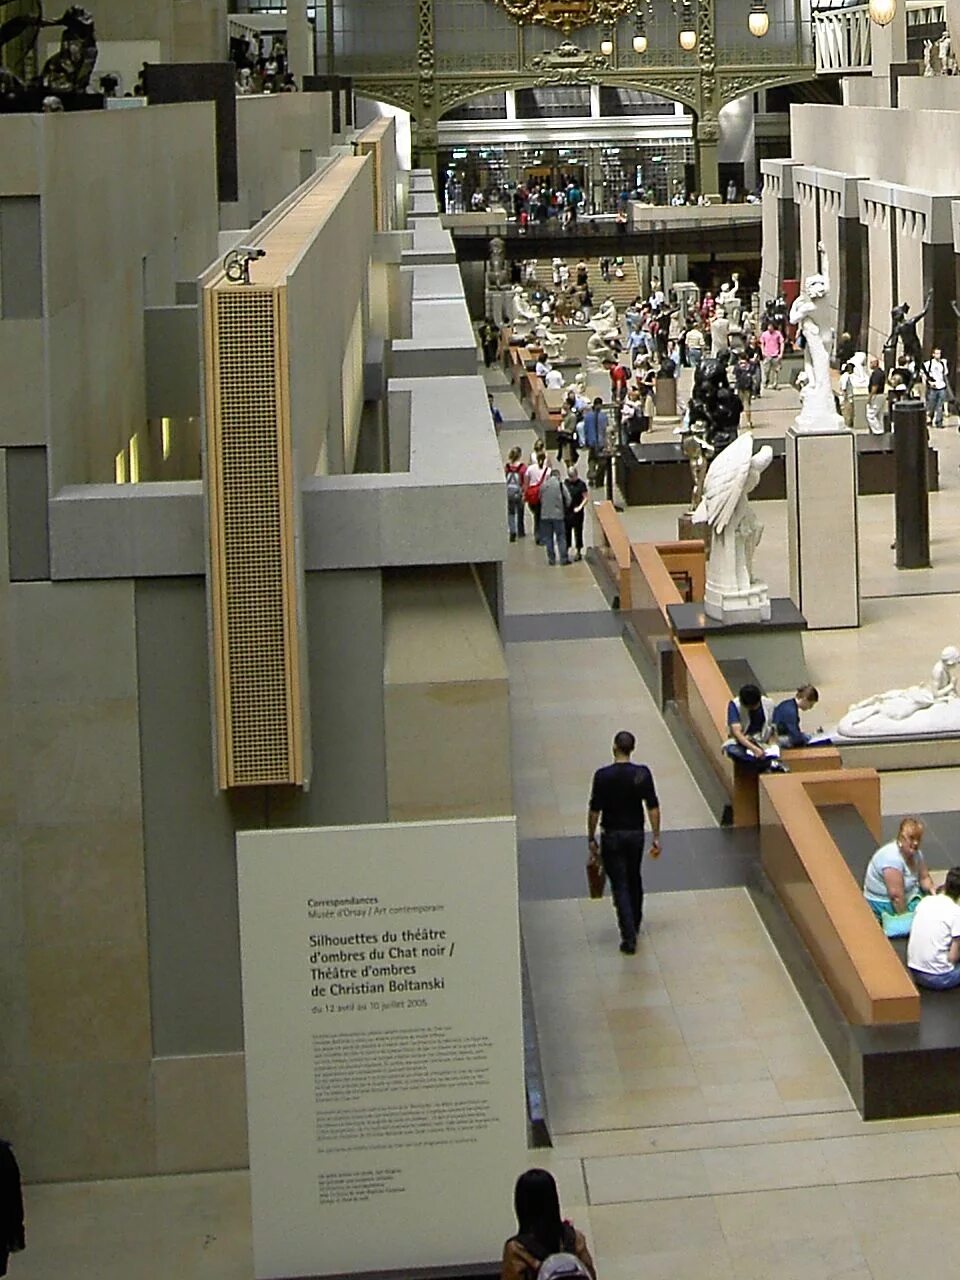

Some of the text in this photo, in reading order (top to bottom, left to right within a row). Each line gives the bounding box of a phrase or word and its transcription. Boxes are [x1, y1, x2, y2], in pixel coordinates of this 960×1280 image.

[374, 907, 387, 916] Art
[309, 927, 447, 948] Silhouettes du théâtre
[309, 949, 366, 964] d'ombres
[369, 948, 385, 960] du
[388, 946, 417, 959] Chat
[421, 943, 446, 957] noir
[310, 963, 417, 981] Théâtre d'ombres
[311, 976, 445, 997] de Christian Boltanski
